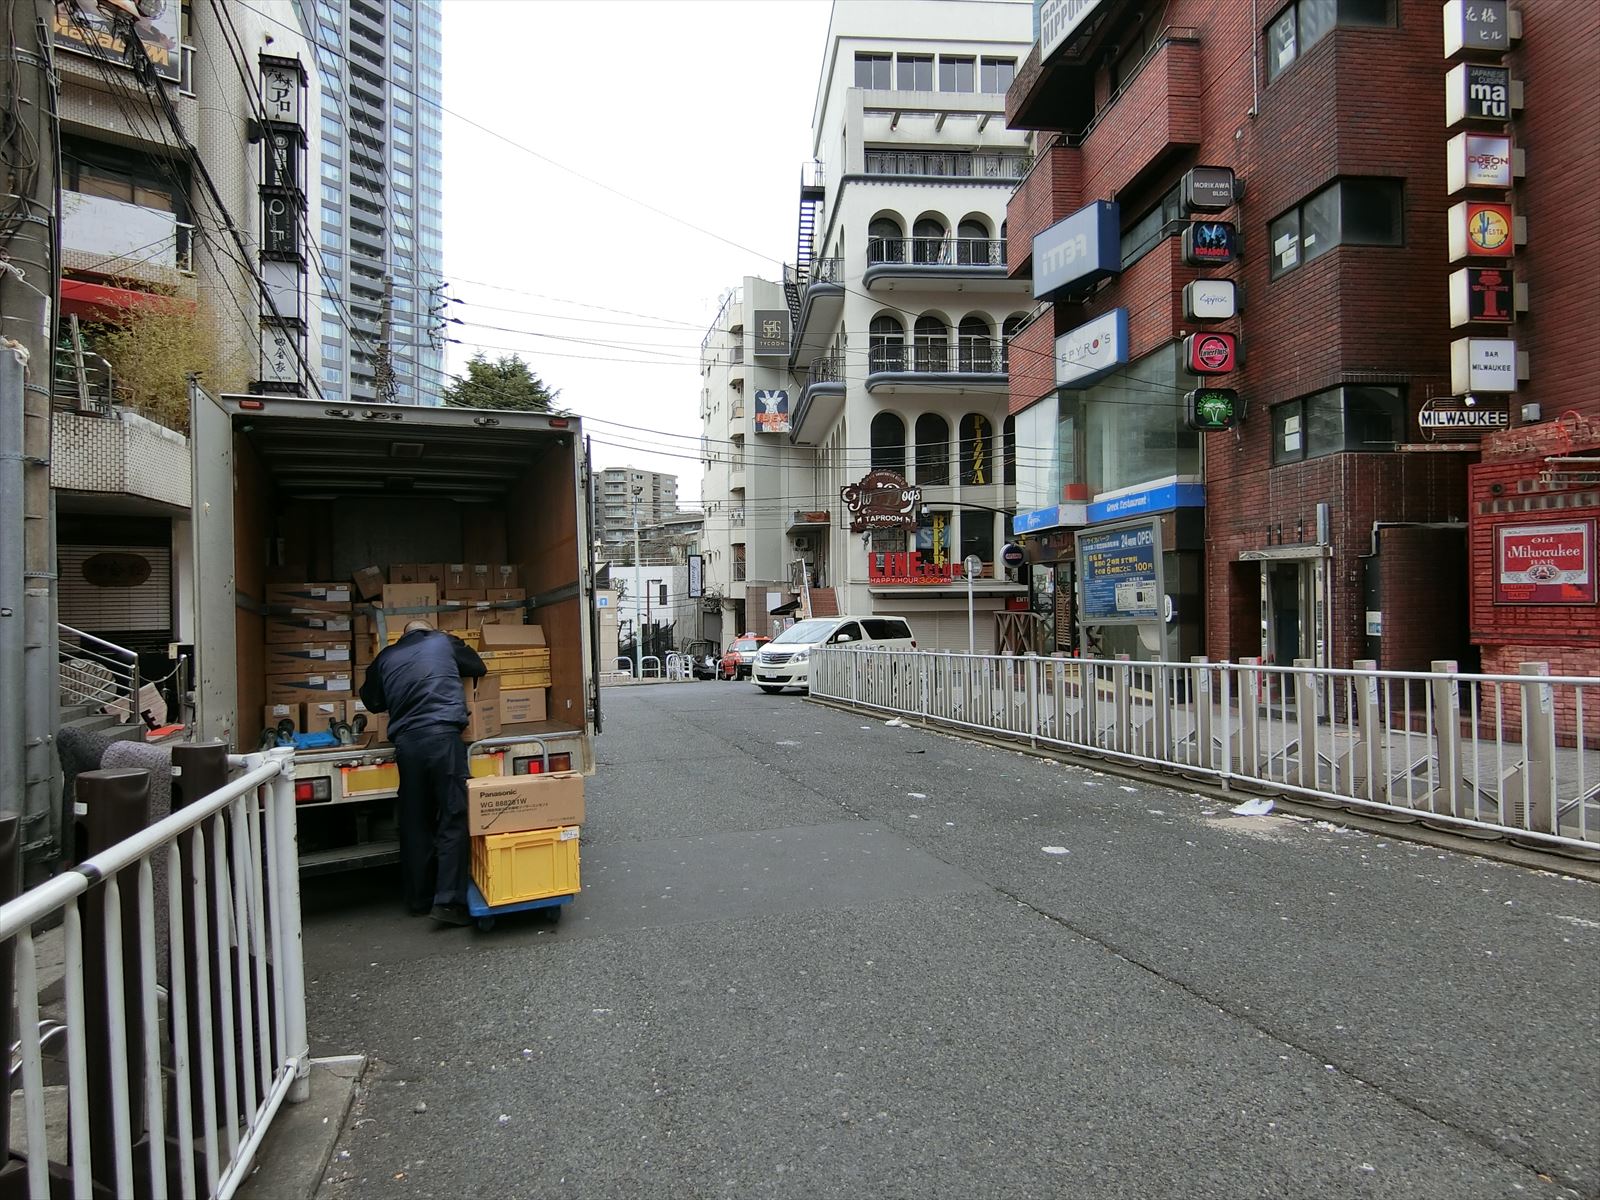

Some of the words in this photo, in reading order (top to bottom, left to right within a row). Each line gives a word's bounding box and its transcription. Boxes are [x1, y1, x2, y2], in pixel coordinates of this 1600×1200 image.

[1471, 69, 1505, 77] JAPANESE
[1470, 84, 1506, 100] ma
[1481, 101, 1506, 116] ru
[1468, 155, 1508, 165] ODEON
[1478, 163, 1498, 171] TOKYO
[1472, 364, 1511, 372] MILWAUKEE
[1421, 411, 1508, 426] MILWAUKEE
[972, 415, 985, 484] PIZZA
[865, 515, 903, 523] TAPROOM
[1137, 530, 1154, 546] OPEN
[1531, 536, 1554, 544] Old
[1507, 544, 1581, 558] Milwaukee
[869, 552, 921, 577] LINE
[924, 563, 963, 577] CLUB
[480, 789, 518, 799] Panasonic
[480, 801, 494, 809] WG
